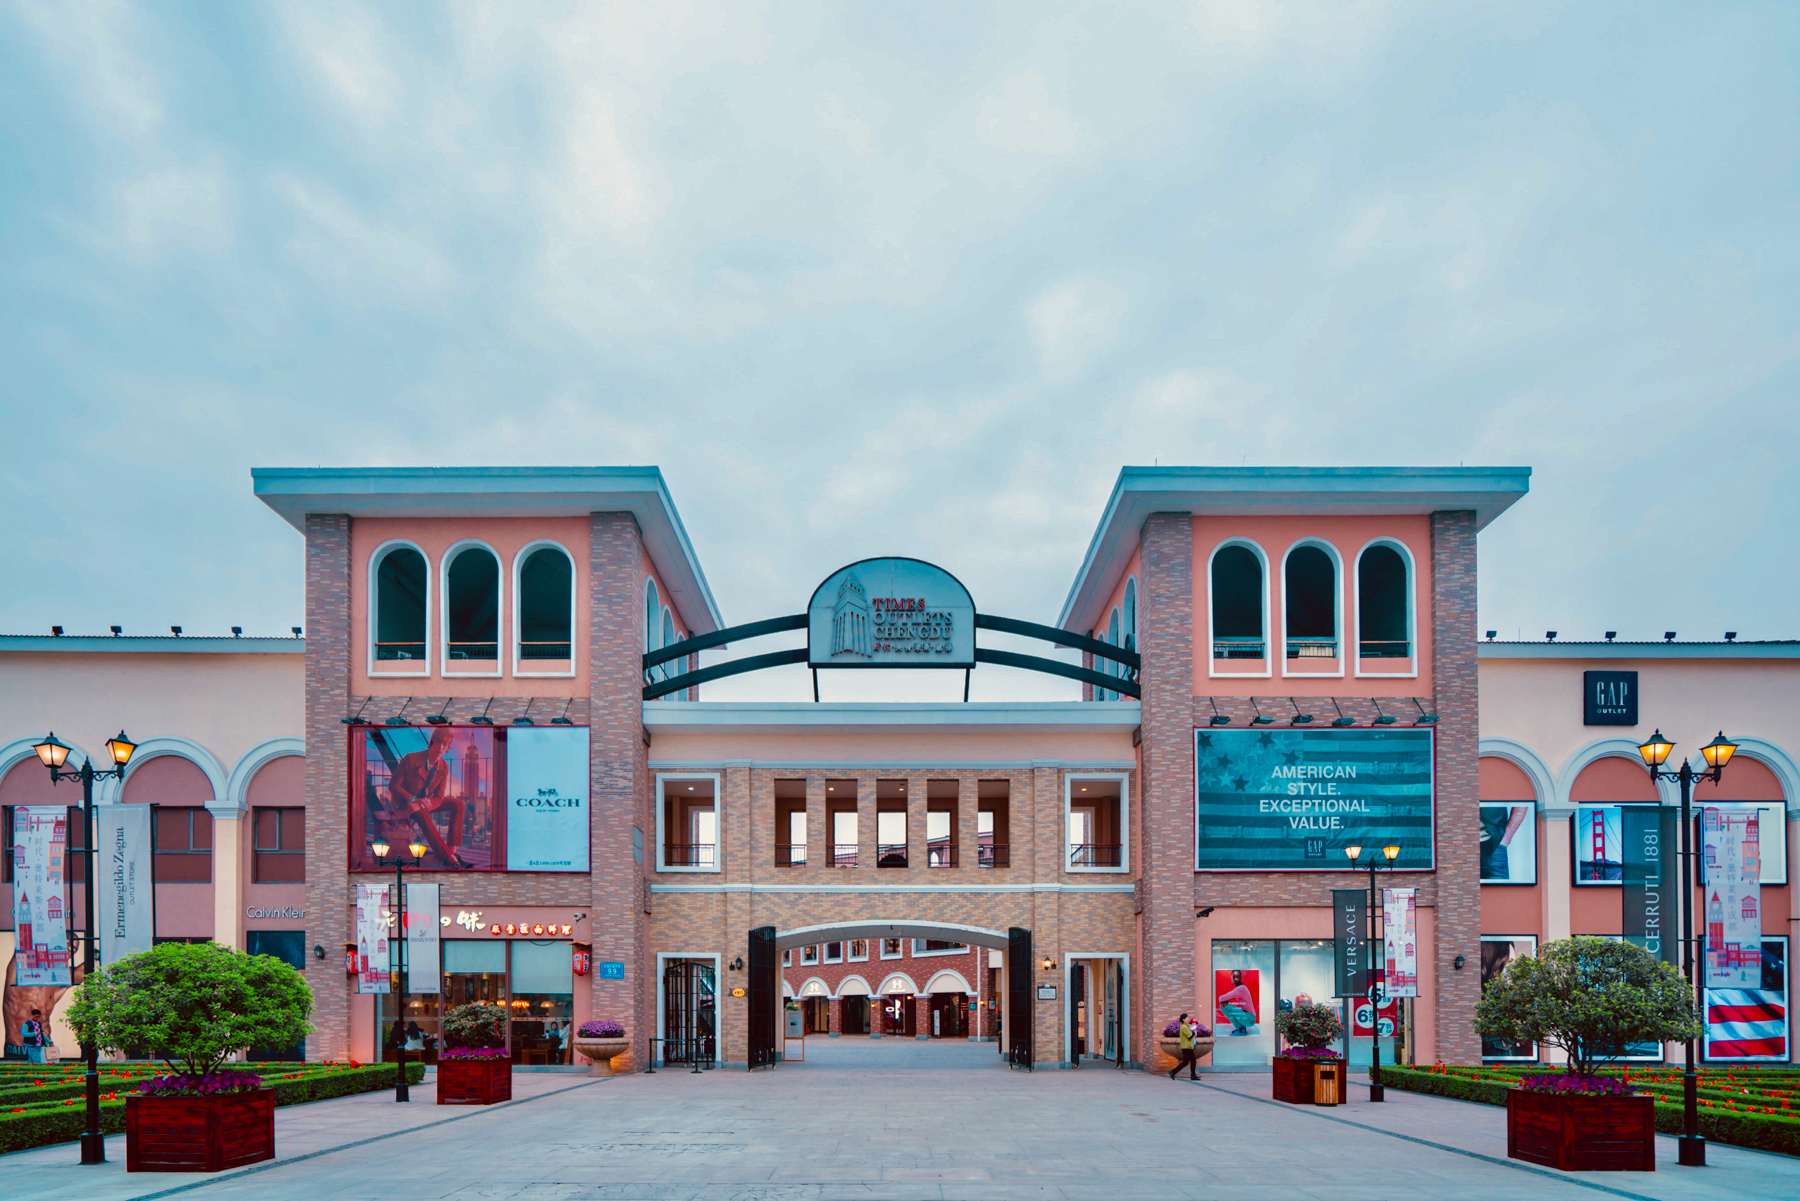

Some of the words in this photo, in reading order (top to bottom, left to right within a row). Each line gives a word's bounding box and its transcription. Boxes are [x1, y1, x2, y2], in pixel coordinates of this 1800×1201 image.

[872, 598, 926, 611] TIMES
[873, 611, 953, 626] OUTLETS
[873, 627, 953, 640] CHENGDU
[1596, 681, 1628, 706] GAP
[1271, 765, 1357, 779] AMERICAN
[1287, 782, 1341, 796] STYLE.
[516, 798, 580, 808] COACH
[1259, 799, 1371, 813] EXCEPTIONAL
[1289, 816, 1345, 830] VALUE.
[113, 827, 127, 863] Zegna
[1307, 840, 1323, 853] GAP
[1643, 829, 1659, 862] 1881
[113, 865, 127, 940] Ermenegildo
[246, 905, 280, 918] Calvin
[1645, 875, 1660, 953] CERRUTI
[1346, 904, 1356, 977] VERSACE
[7, 1044, 28, 1055] CALV
